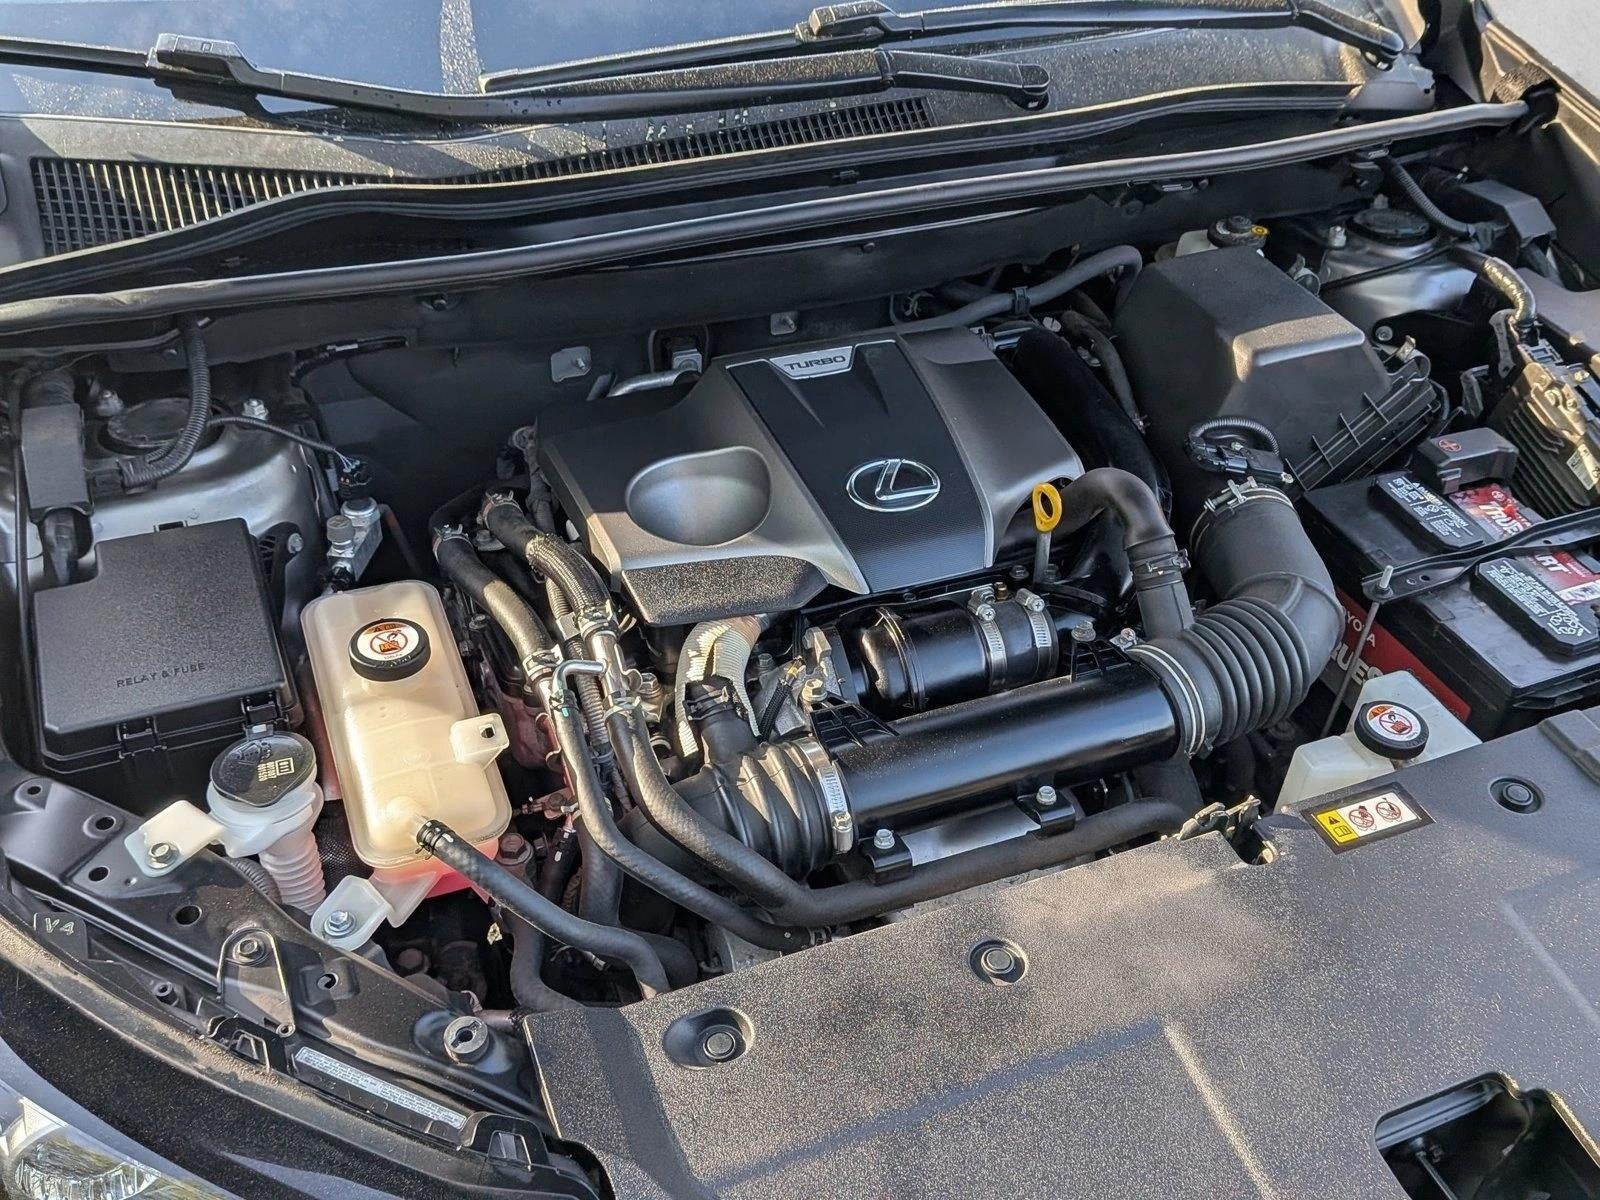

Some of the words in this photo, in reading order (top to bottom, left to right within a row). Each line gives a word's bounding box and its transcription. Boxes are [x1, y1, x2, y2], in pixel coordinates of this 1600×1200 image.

[784, 355, 846, 371] TURBO
[116, 672, 157, 688] RELAY
[161, 670, 171, 679] &
[174, 663, 206, 677] FUSE
